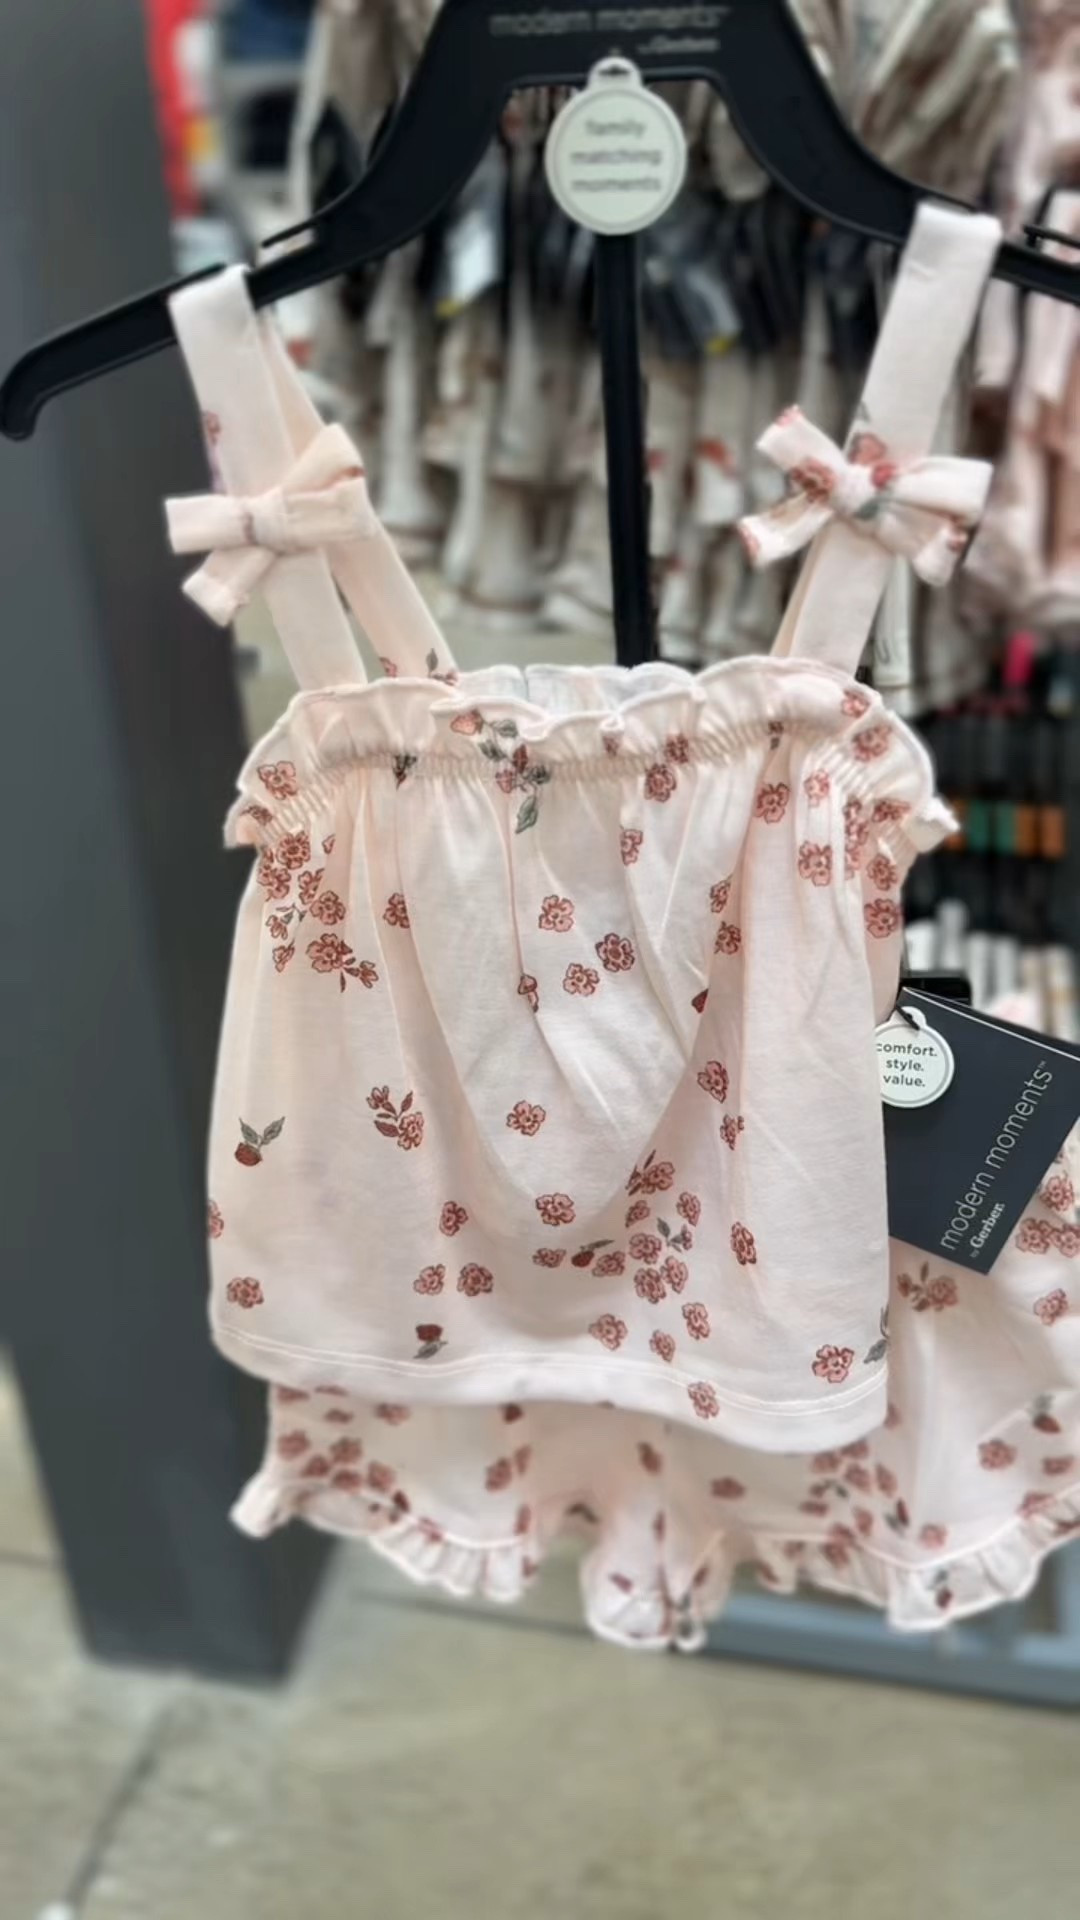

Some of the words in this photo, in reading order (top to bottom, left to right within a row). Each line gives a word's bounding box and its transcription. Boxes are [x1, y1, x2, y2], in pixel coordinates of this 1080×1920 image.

[585, 119, 647, 138] family
[570, 149, 662, 166] matching
[571, 178, 662, 192] moments
[886, 1059, 924, 1072] style.
[883, 1075, 925, 1087] value.
[940, 1172, 995, 1250] modern
